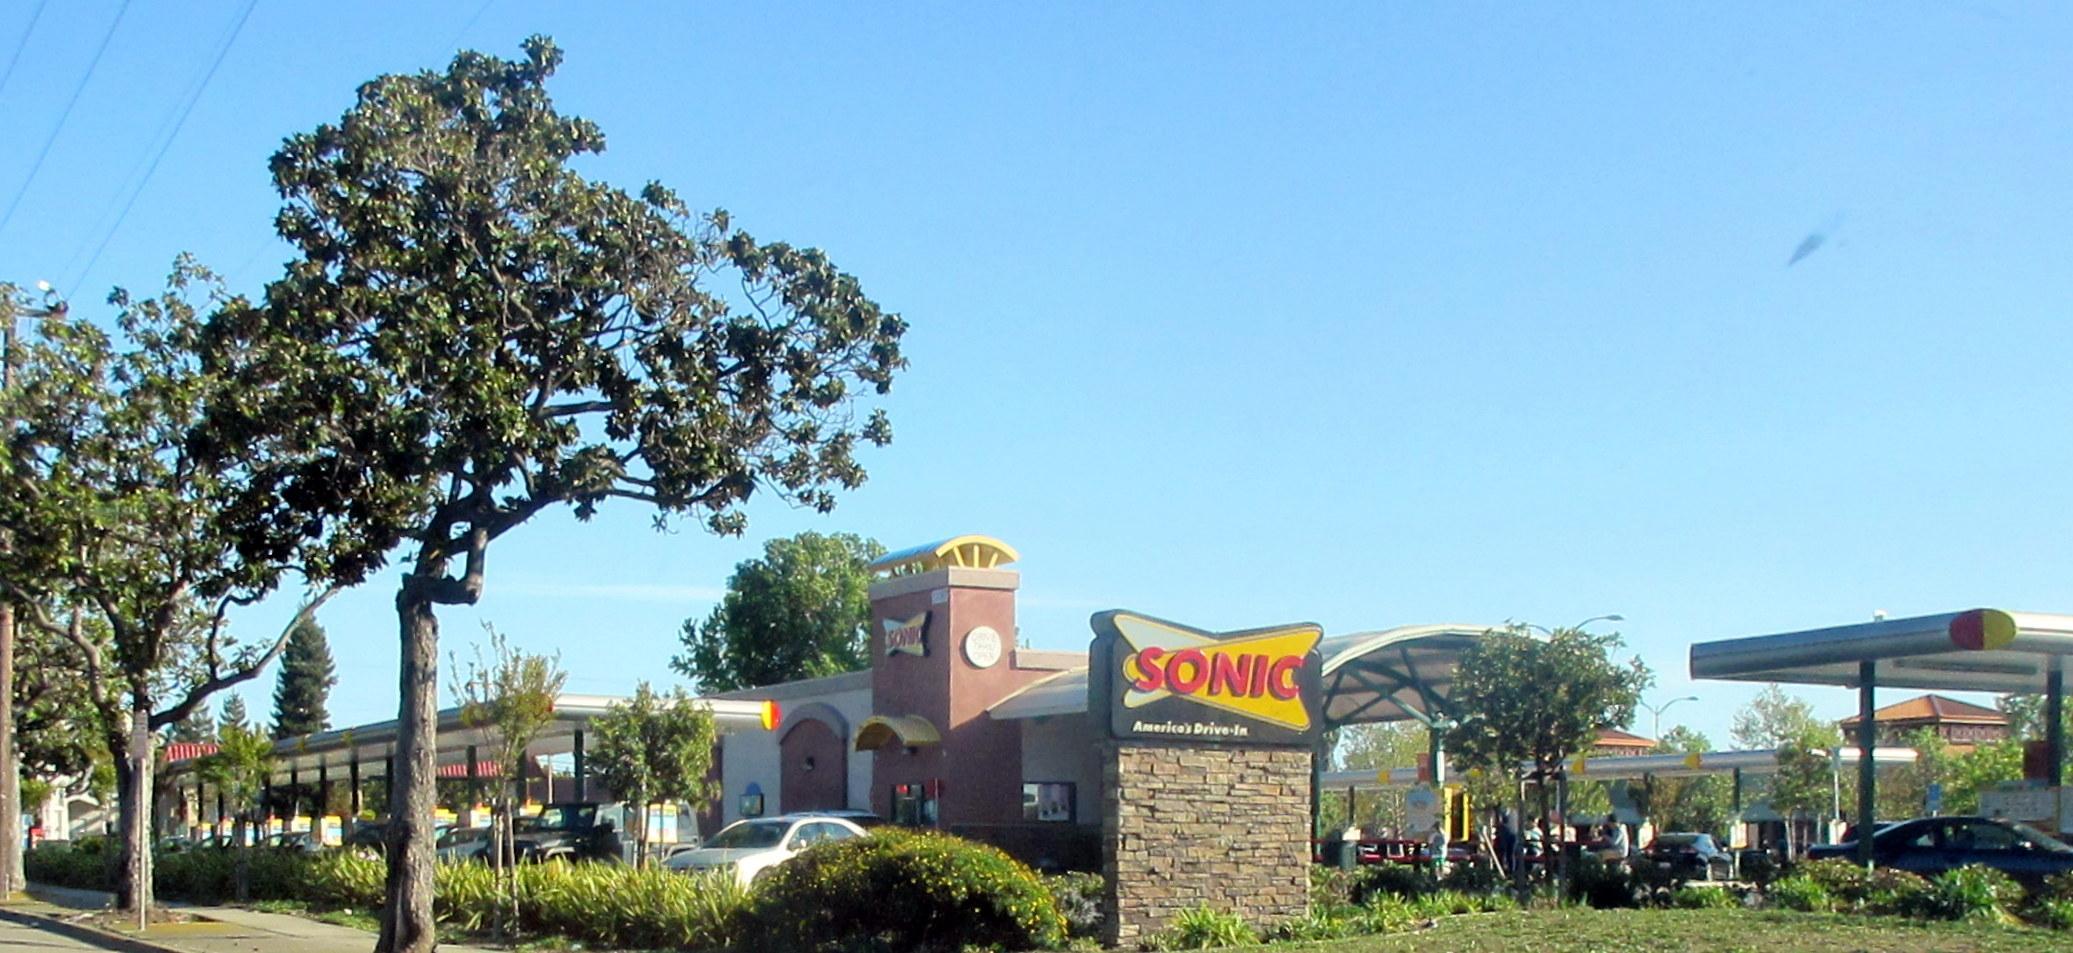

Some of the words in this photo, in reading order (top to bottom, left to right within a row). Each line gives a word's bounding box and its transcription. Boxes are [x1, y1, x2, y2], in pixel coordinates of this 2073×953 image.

[886, 627, 923, 648] SONIC
[1131, 646, 1305, 700] SONIC
[1132, 720, 1192, 734] America's
[1192, 721, 1249, 737] Drive-In
